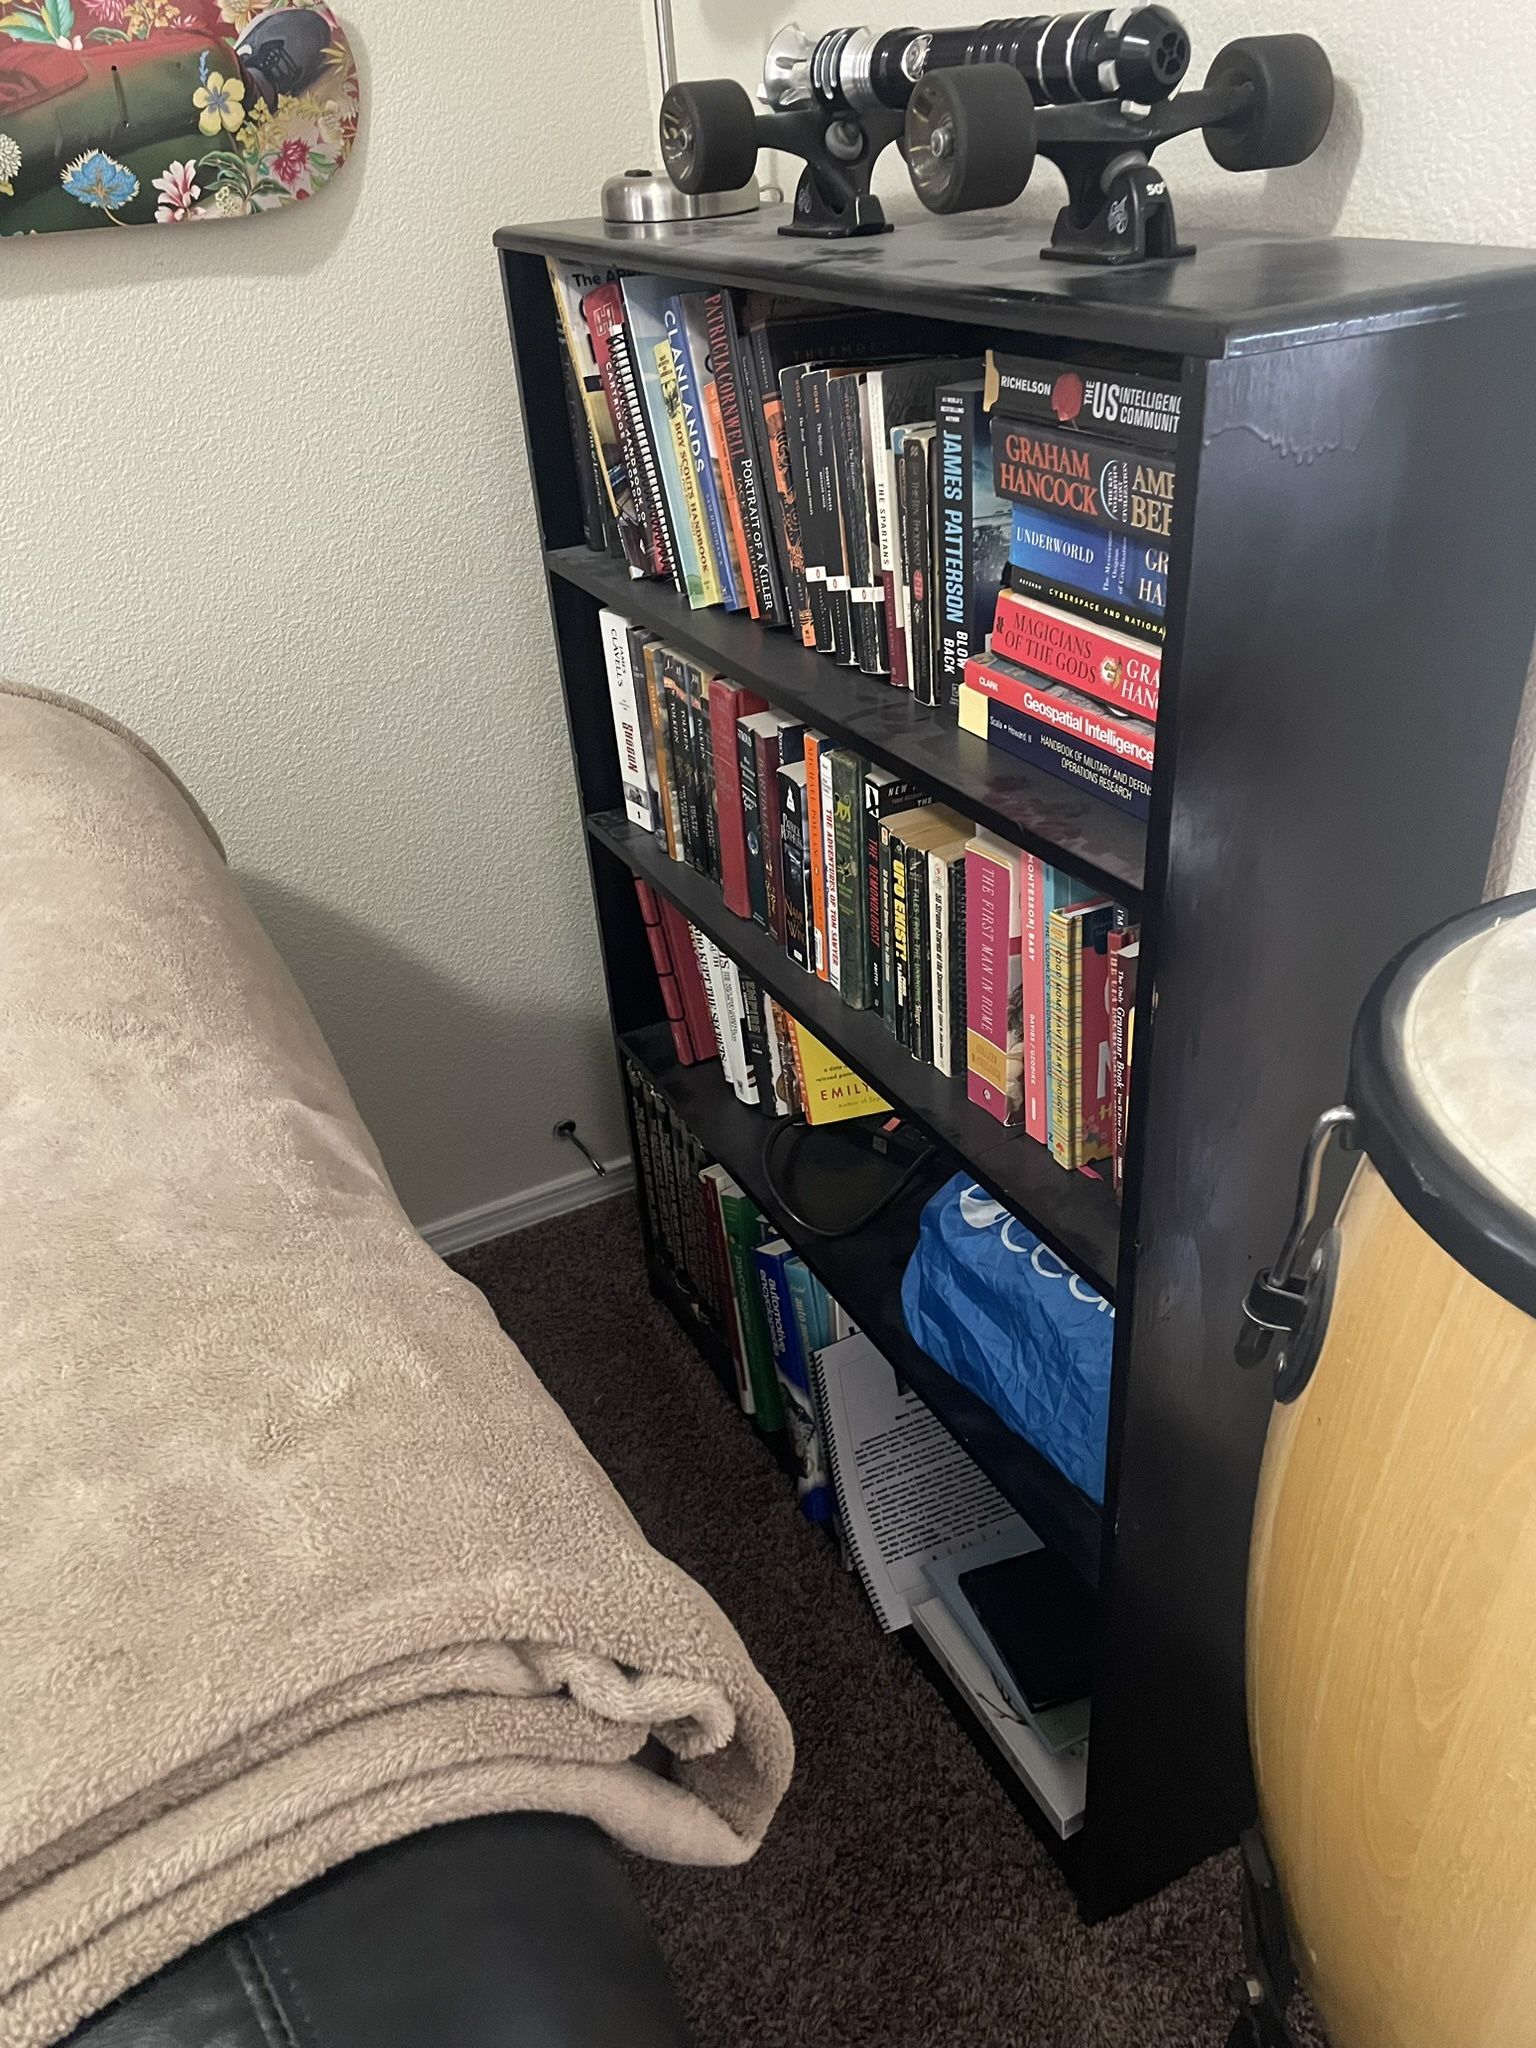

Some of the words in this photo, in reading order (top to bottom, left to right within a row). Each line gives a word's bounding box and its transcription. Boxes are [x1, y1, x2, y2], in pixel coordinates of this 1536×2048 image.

[572, 273, 601, 287] The
[701, 293, 734, 372] PATRICIA
[604, 360, 626, 438] CARTRIDGE
[662, 308, 706, 473] CLANLANDS
[811, 384, 821, 413] HOMER
[1001, 375, 1051, 396] RICHELSON
[1084, 380, 1095, 405] THE
[1092, 381, 1120, 421] US
[673, 420, 686, 447] BOY
[714, 371, 749, 459] CORNWELL
[679, 450, 694, 498] SCOUTS
[943, 430, 963, 501] JAMES
[1006, 434, 1090, 481] GRAHAM
[737, 457, 765, 529] PORTRAIT
[876, 483, 886, 503] THE
[1001, 463, 1099, 517] HANCOCK
[689, 502, 709, 573] HANDBOOK
[751, 531, 763, 548] OF
[755, 550, 764, 560] A
[877, 508, 891, 566] SPARTANS
[1017, 526, 1094, 565] UNDERWORLD
[944, 508, 965, 625] PATTERSON
[755, 562, 777, 611] KILLER
[1049, 588, 1100, 612] CYBERSPACE
[1104, 607, 1121, 619] AND
[1138, 577, 1166, 608] HA
[956, 630, 969, 669] BLOW
[1014, 612, 1092, 659] MAGICIANS
[608, 627, 625, 687] CLAVELL'S
[943, 637, 955, 674] BACK
[1005, 630, 1022, 650] OF
[1026, 639, 1053, 665] THE
[1056, 652, 1096, 684] GODS
[979, 676, 999, 692] CLARK
[670, 702, 680, 744] TOLKIEN
[680, 709, 690, 751] TOLKIEN
[697, 717, 707, 760] TOLKIEN
[1023, 692, 1082, 733] Geospatial
[1085, 718, 1155, 765] Intelligence
[1040, 734, 1074, 759] HANDBOOK
[1074, 751, 1083, 761] OF
[1083, 754, 1112, 777] MILITARY
[1112, 769, 1128, 784] AND
[888, 784, 908, 797] NEW
[1061, 757, 1098, 785] OPERATIONS
[1099, 777, 1132, 801] RESEARCH
[825, 830, 835, 892] ADVENTURES
[868, 837, 878, 860] THE
[892, 858, 905, 899] UFO
[981, 867, 994, 896] THE
[828, 893, 836, 907] OF
[866, 862, 883, 948] DEMONOLOGIST
[912, 888, 920, 914] TALES
[934, 893, 942, 904] 50
[1113, 908, 1126, 926] I'M
[893, 897, 907, 962] EXIST!
[912, 915, 920, 940] FROM
[981, 898, 994, 941] FIRST
[830, 930, 838, 967] SAWYER
[912, 942, 921, 960] THE
[980, 942, 993, 974] MAN
[1027, 932, 1035, 961] BABY
[697, 950, 712, 987] KEPT
[981, 976, 993, 992] IN
[704, 985, 718, 1011] THE
[980, 994, 993, 1034] ROME
[1054, 982, 1062, 1012] MOMS
[709, 1010, 730, 1063] SECRETS
[1115, 1005, 1125, 1059] Grammar
[820, 1082, 869, 1101] EMILY
[1115, 1060, 1125, 1089] Book
